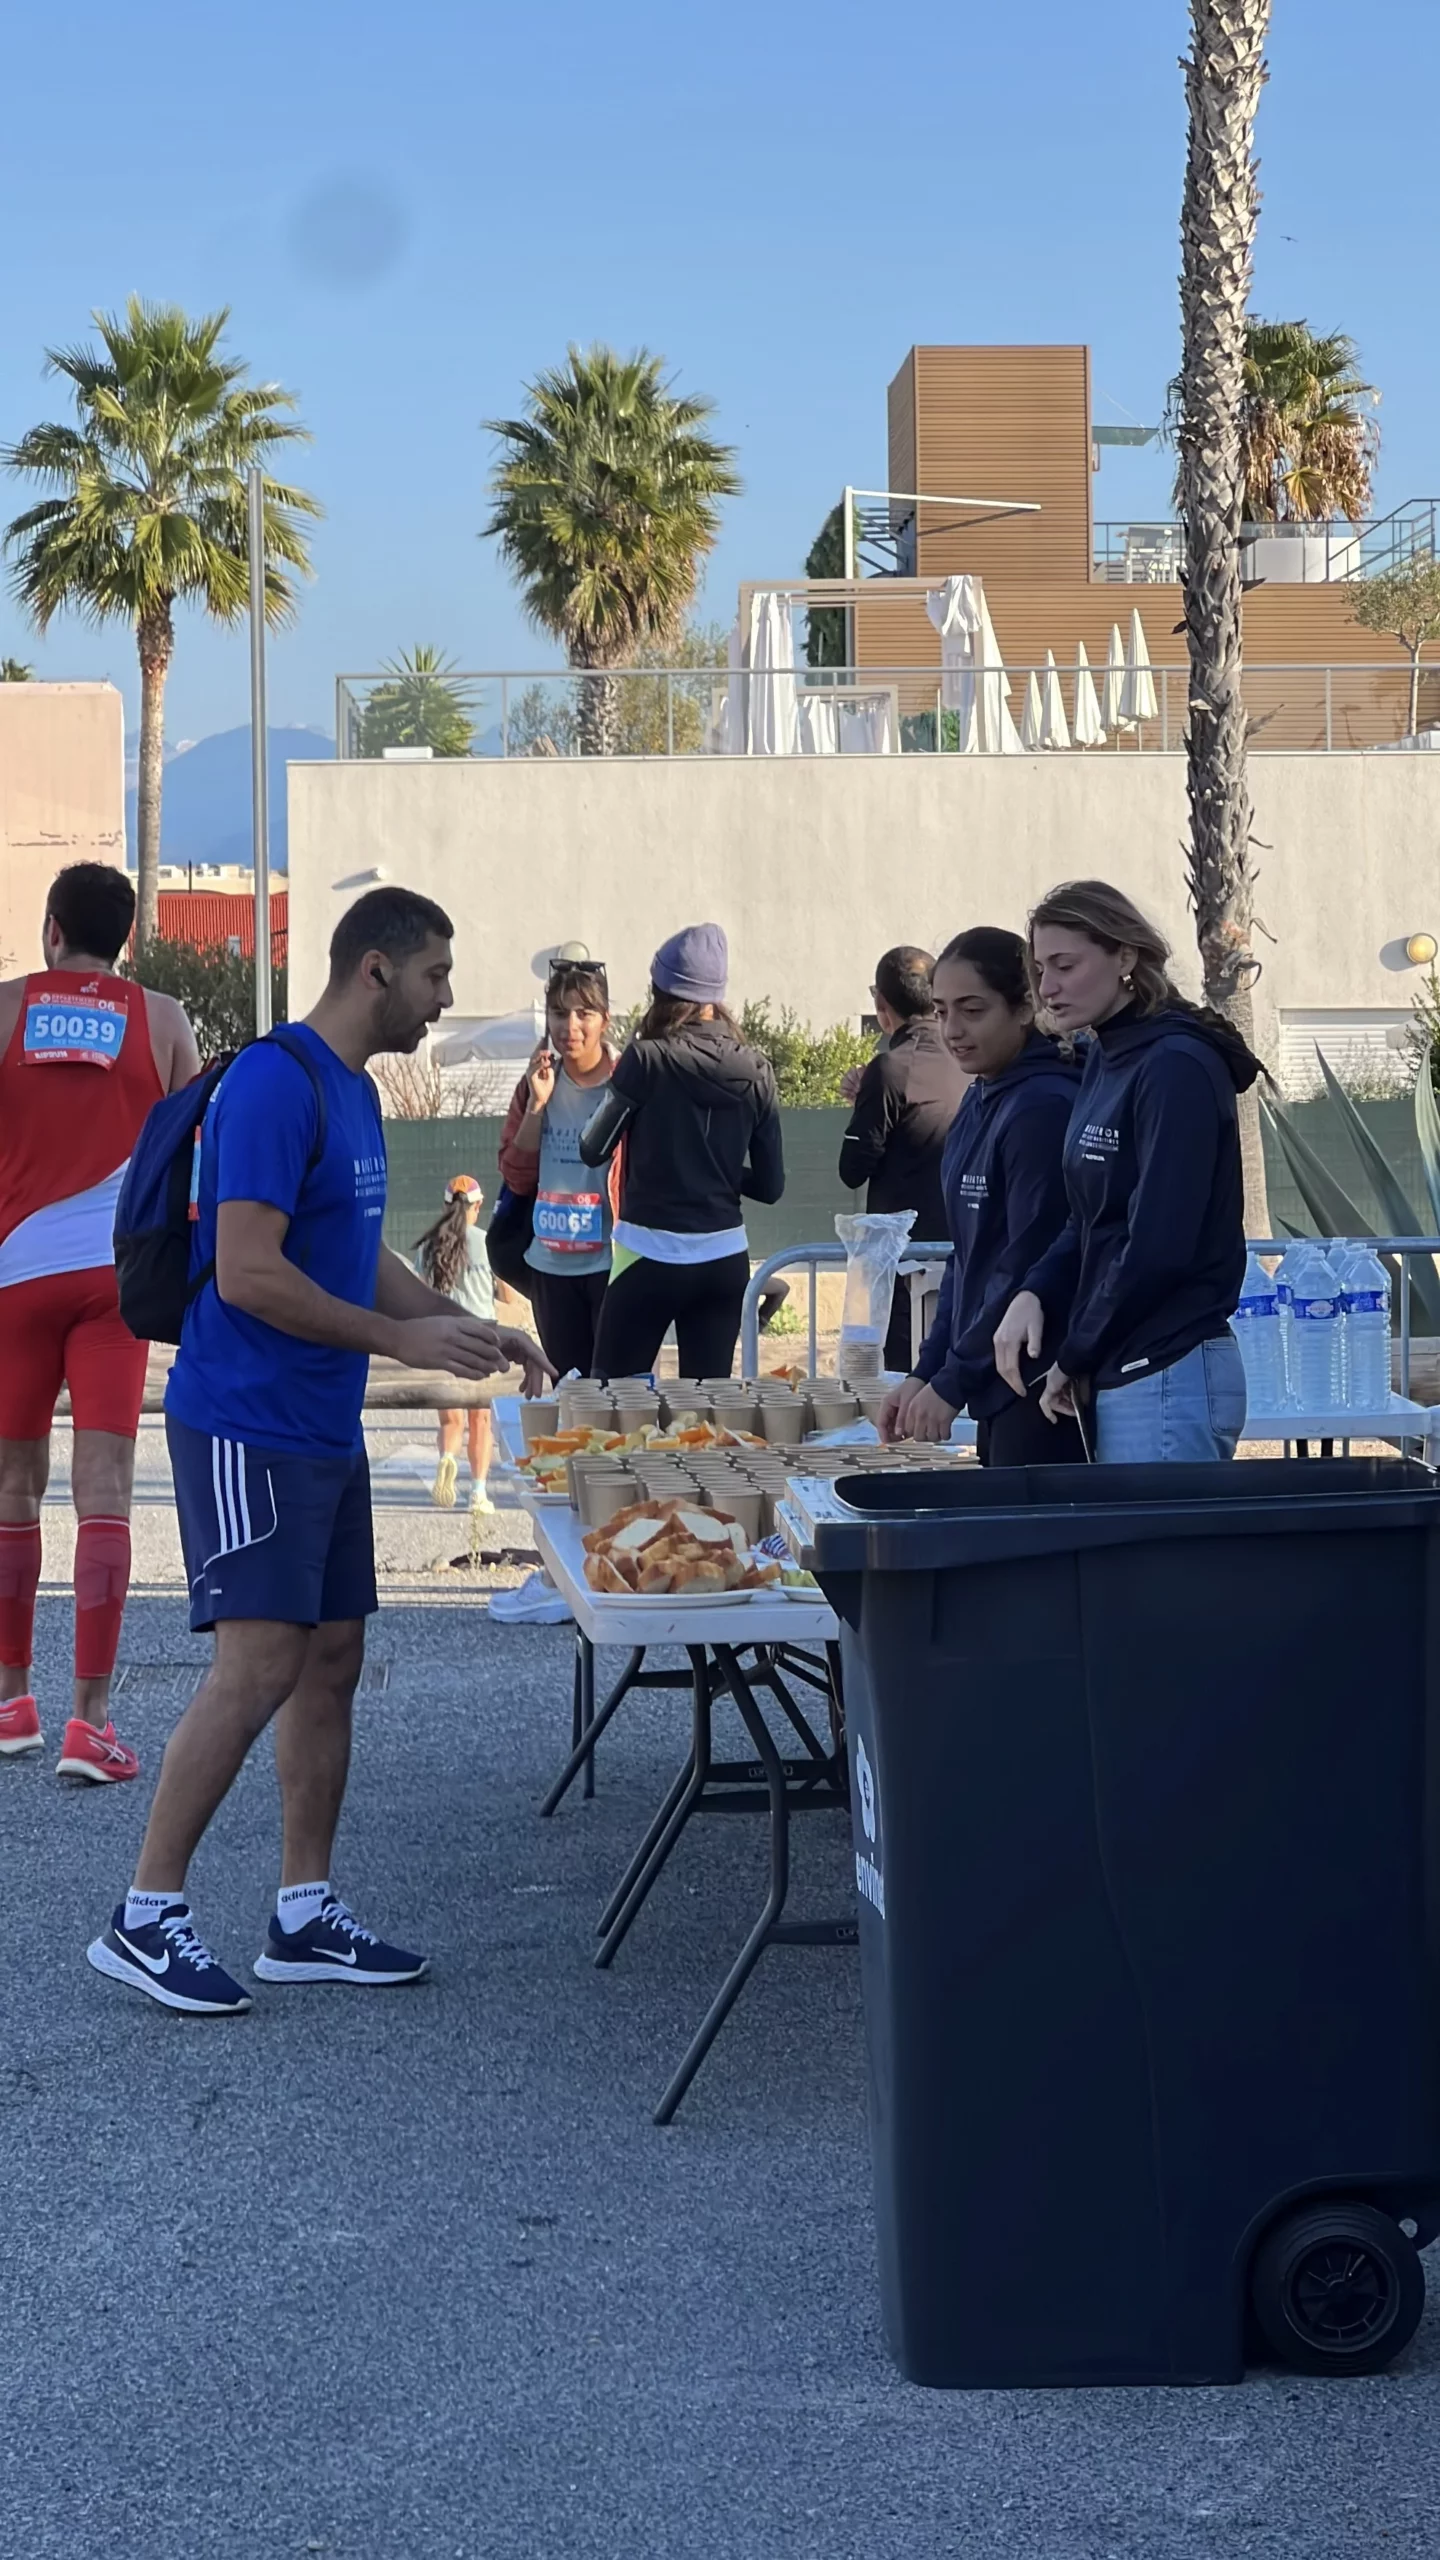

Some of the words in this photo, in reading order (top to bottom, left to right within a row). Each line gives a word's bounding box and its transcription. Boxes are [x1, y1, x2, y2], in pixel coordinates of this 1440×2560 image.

[98, 1000, 115, 1012] 06
[34, 1015, 116, 1043] 50039
[577, 1195, 592, 1205] 06
[538, 1210, 593, 1234] 60065
[281, 1887, 325, 1903] adidas
